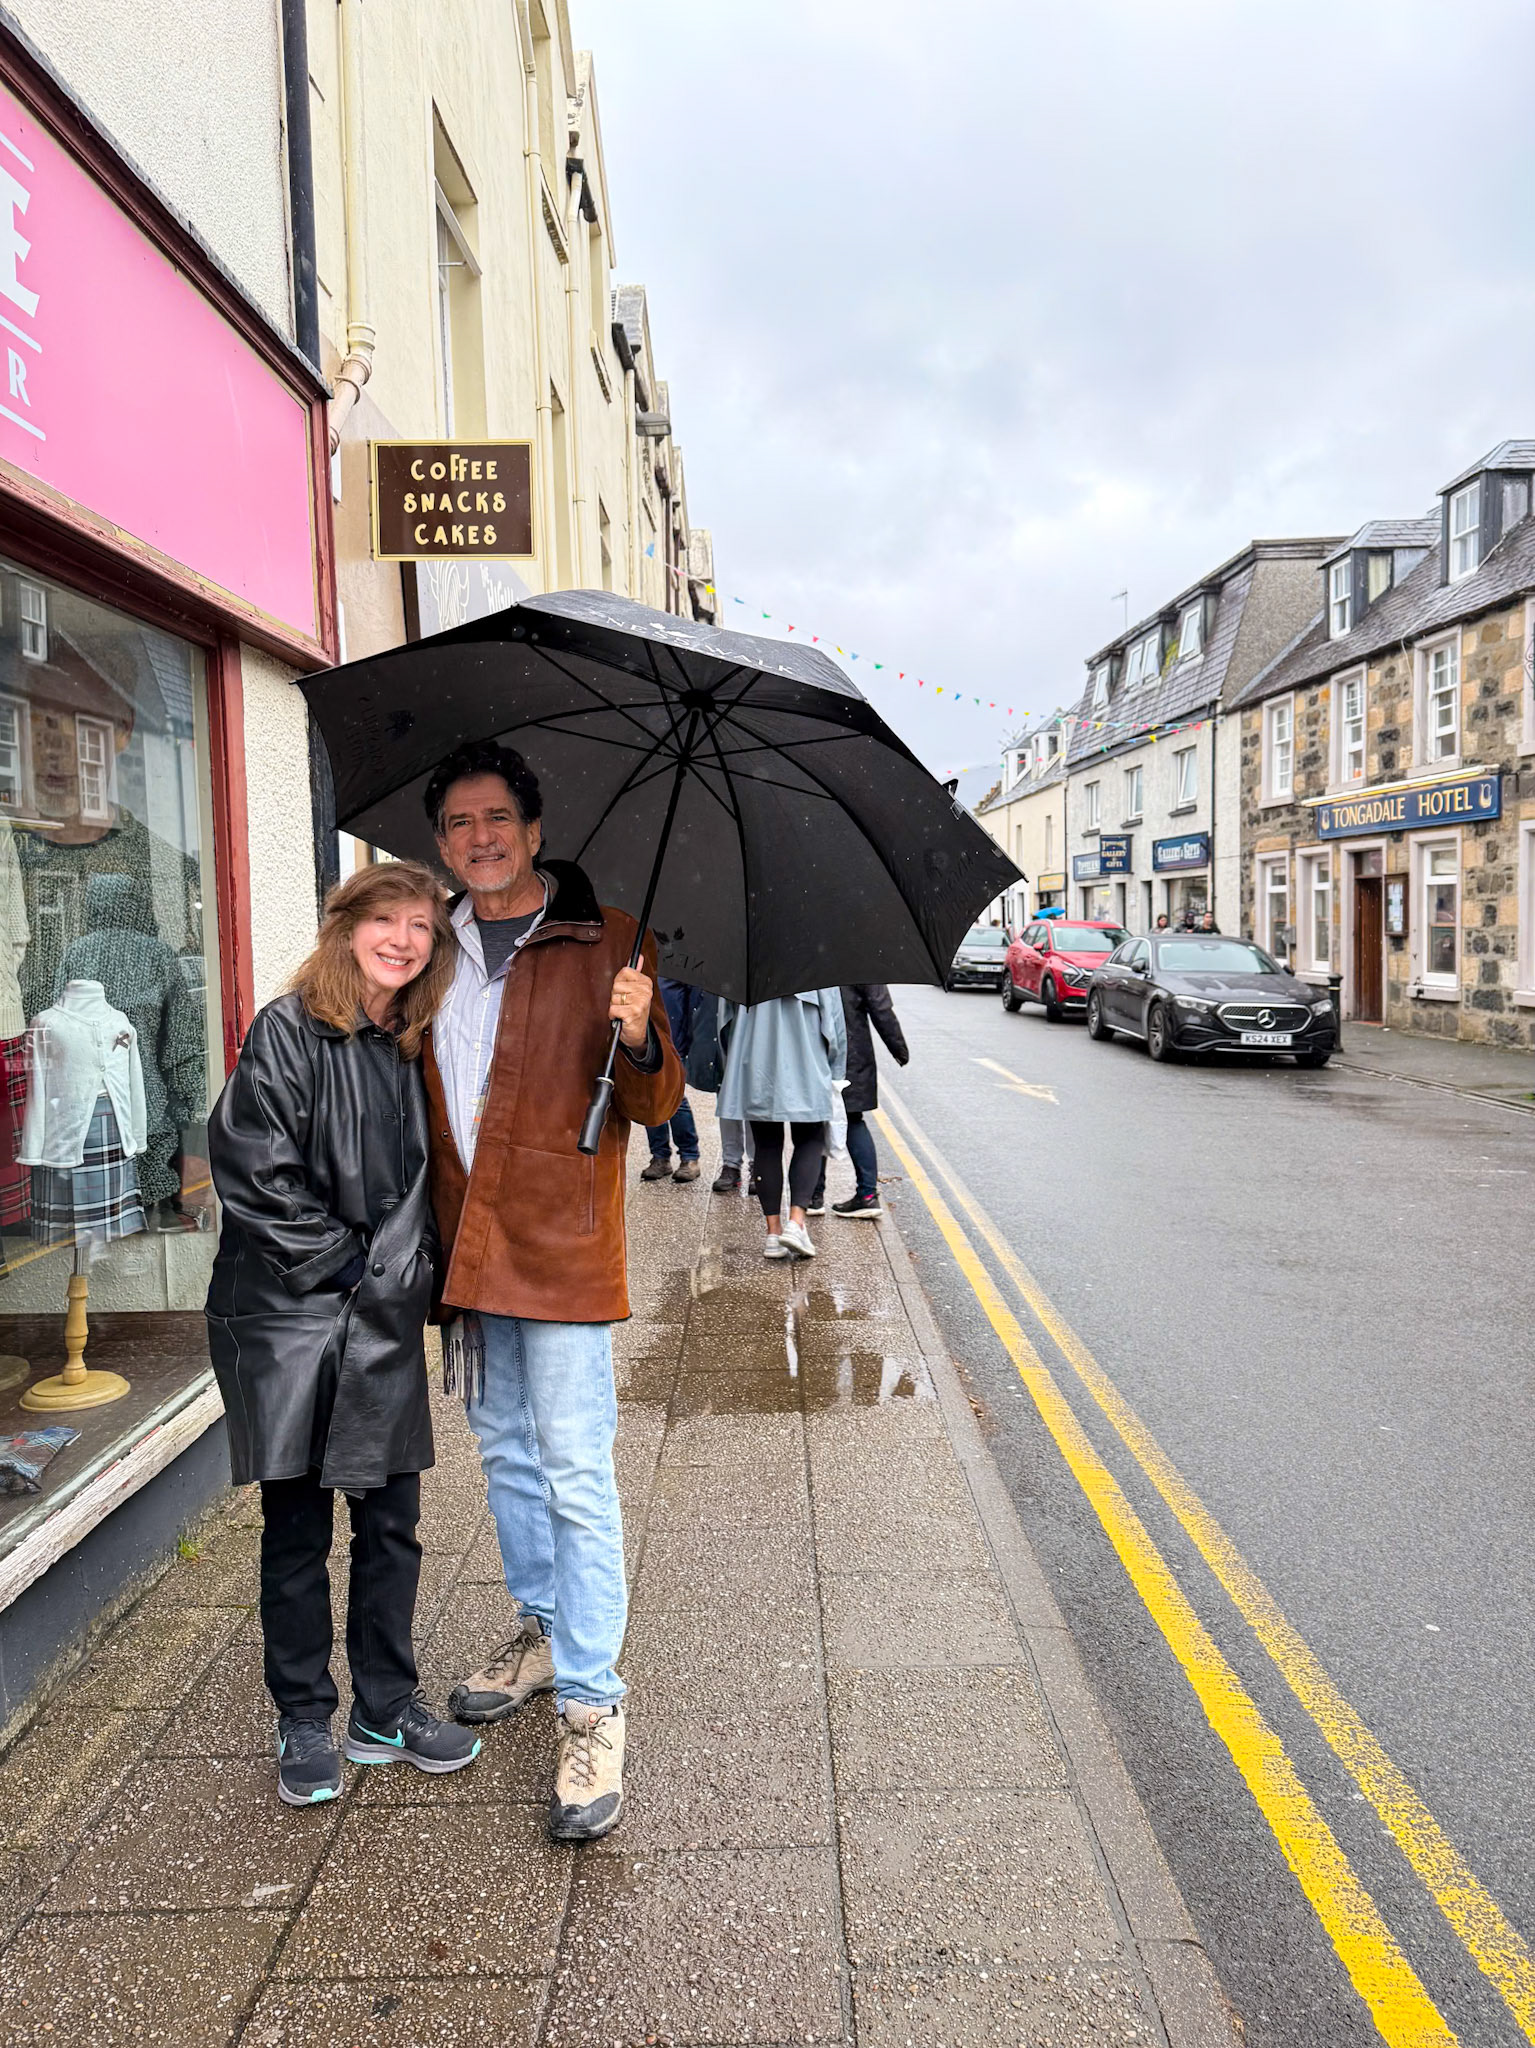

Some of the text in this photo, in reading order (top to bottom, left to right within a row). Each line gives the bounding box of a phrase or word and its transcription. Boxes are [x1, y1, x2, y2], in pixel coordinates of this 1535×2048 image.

[7, 347, 32, 408] R
[410, 453, 498, 482] COFFEE
[403, 491, 506, 514] SNACKS
[414, 523, 497, 546] CAKES
[606, 615, 794, 675] NESS WALK
[1332, 786, 1473, 828] TONGADALE HOTEL
[1245, 1034, 1268, 1043] KS24
